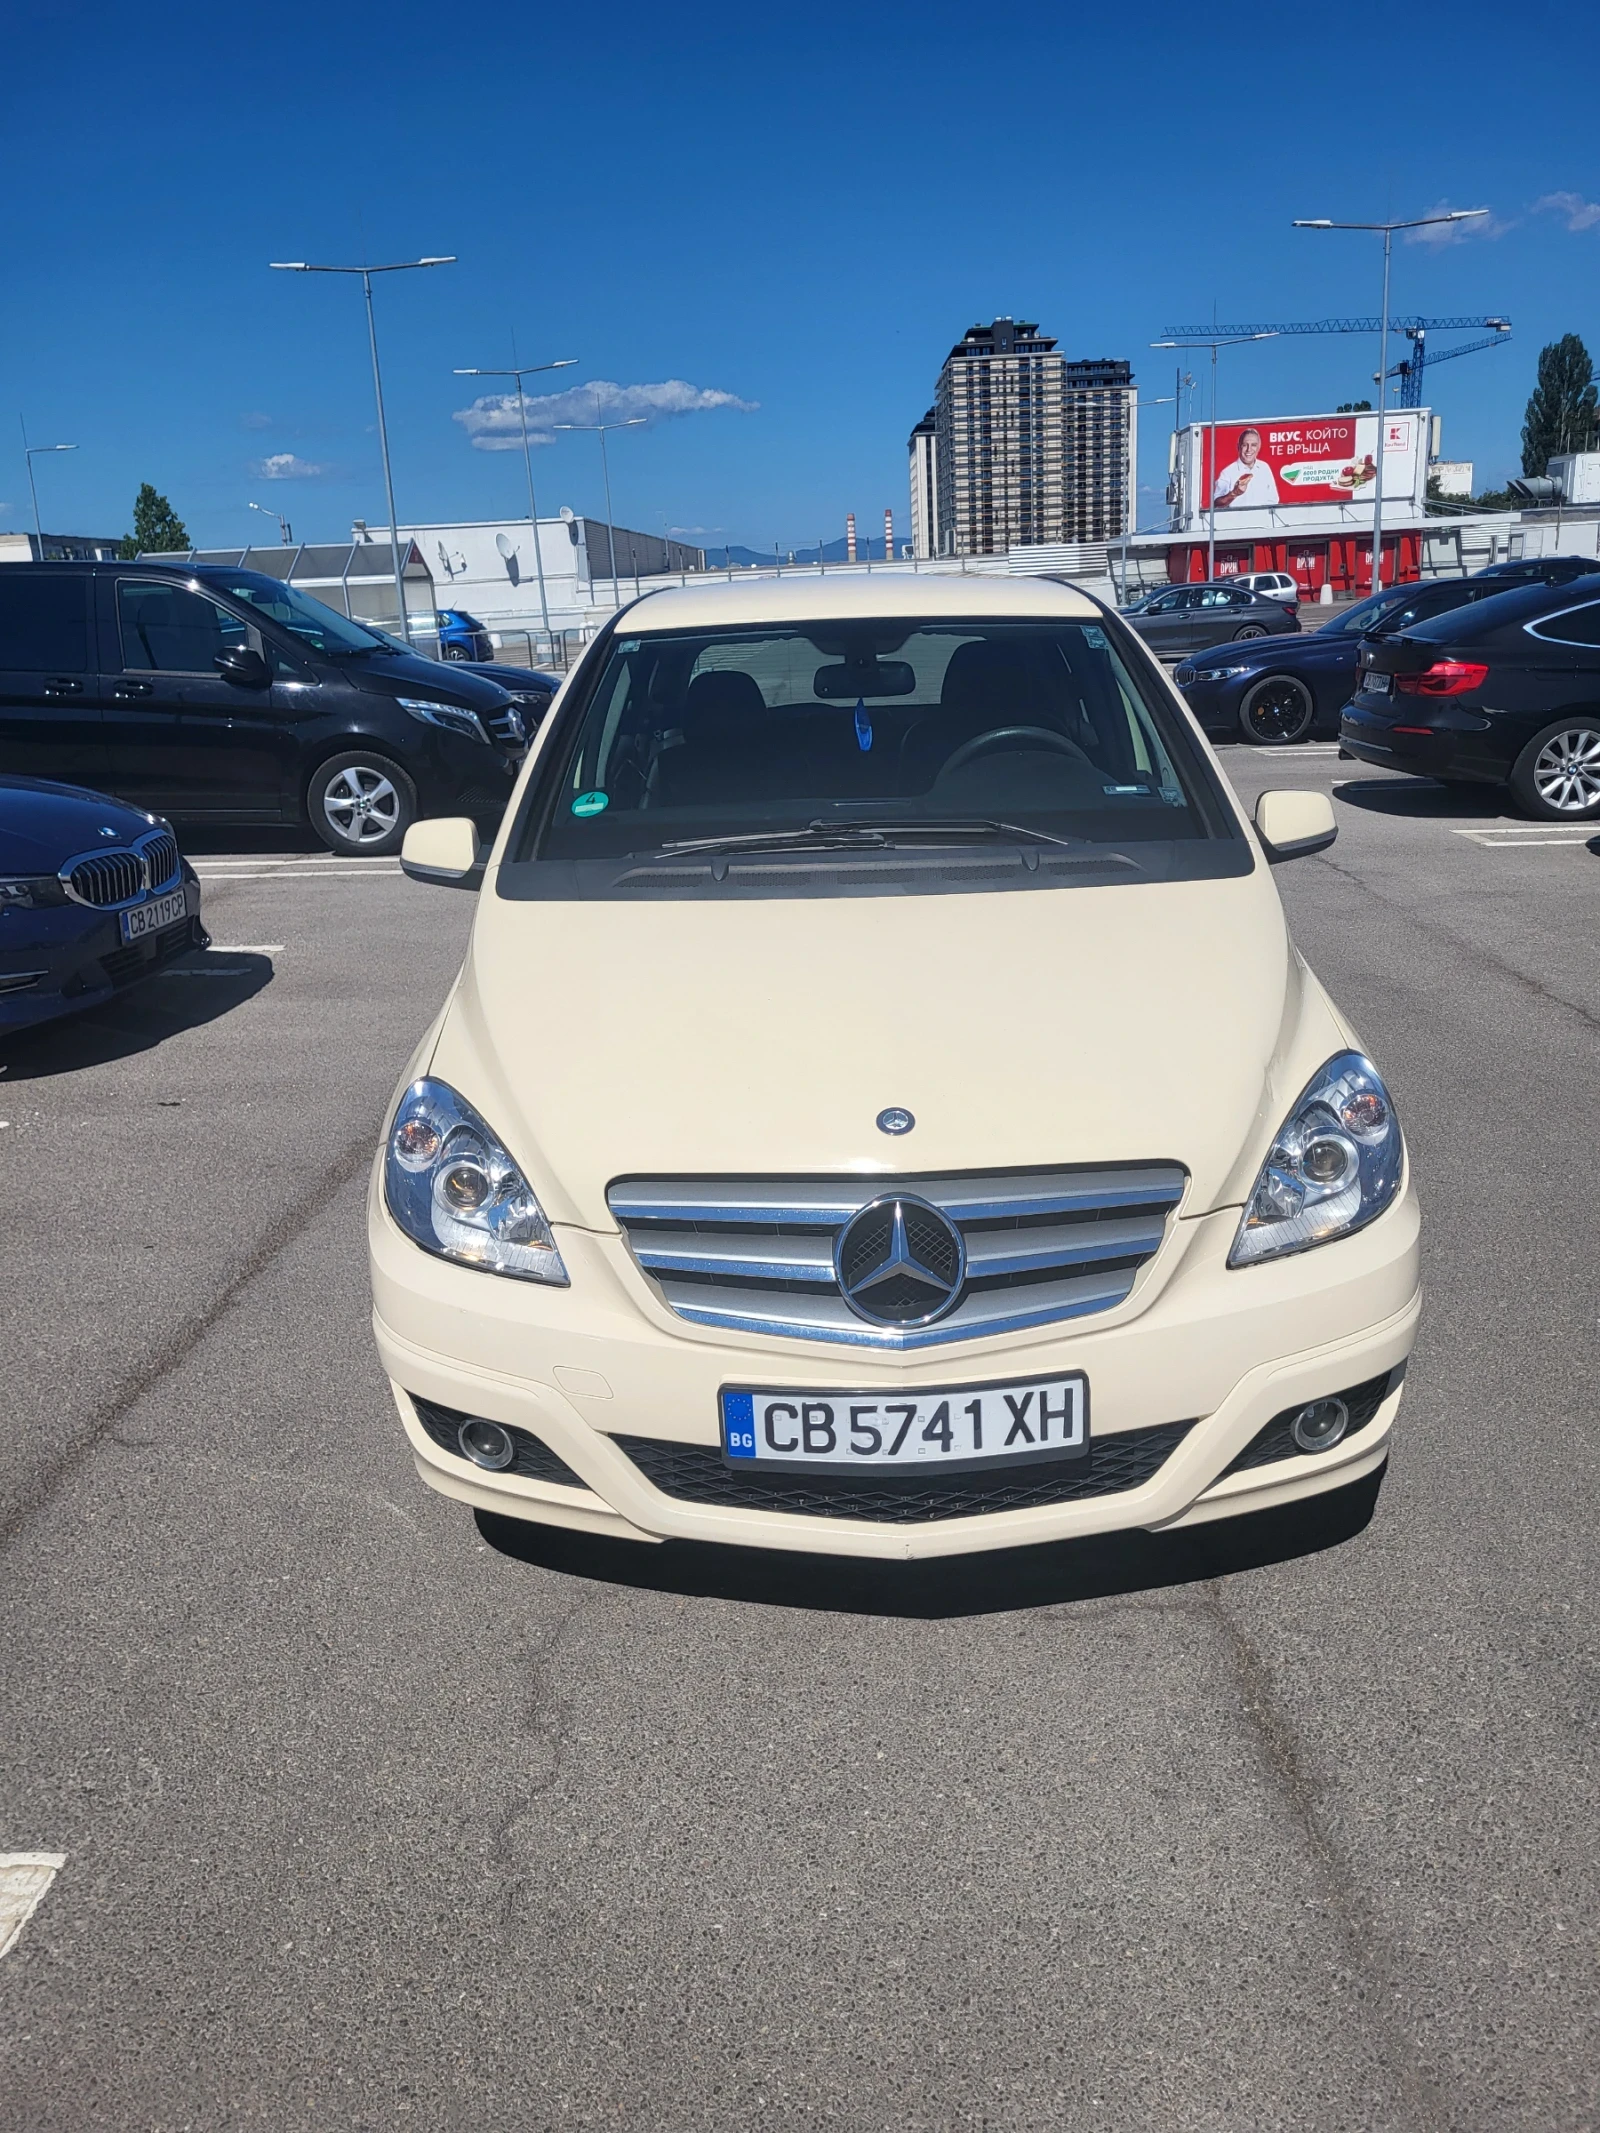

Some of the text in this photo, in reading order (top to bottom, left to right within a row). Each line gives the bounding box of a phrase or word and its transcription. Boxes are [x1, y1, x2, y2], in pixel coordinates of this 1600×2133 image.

[1269, 427, 1348, 443] ВКУС, КОЙТО
[1269, 442, 1330, 456] ТЕ ВРЪЩА
[1318, 468, 1339, 476] РОДНИ
[586, 793, 595, 804] 4
[730, 1432, 753, 1448] BG
